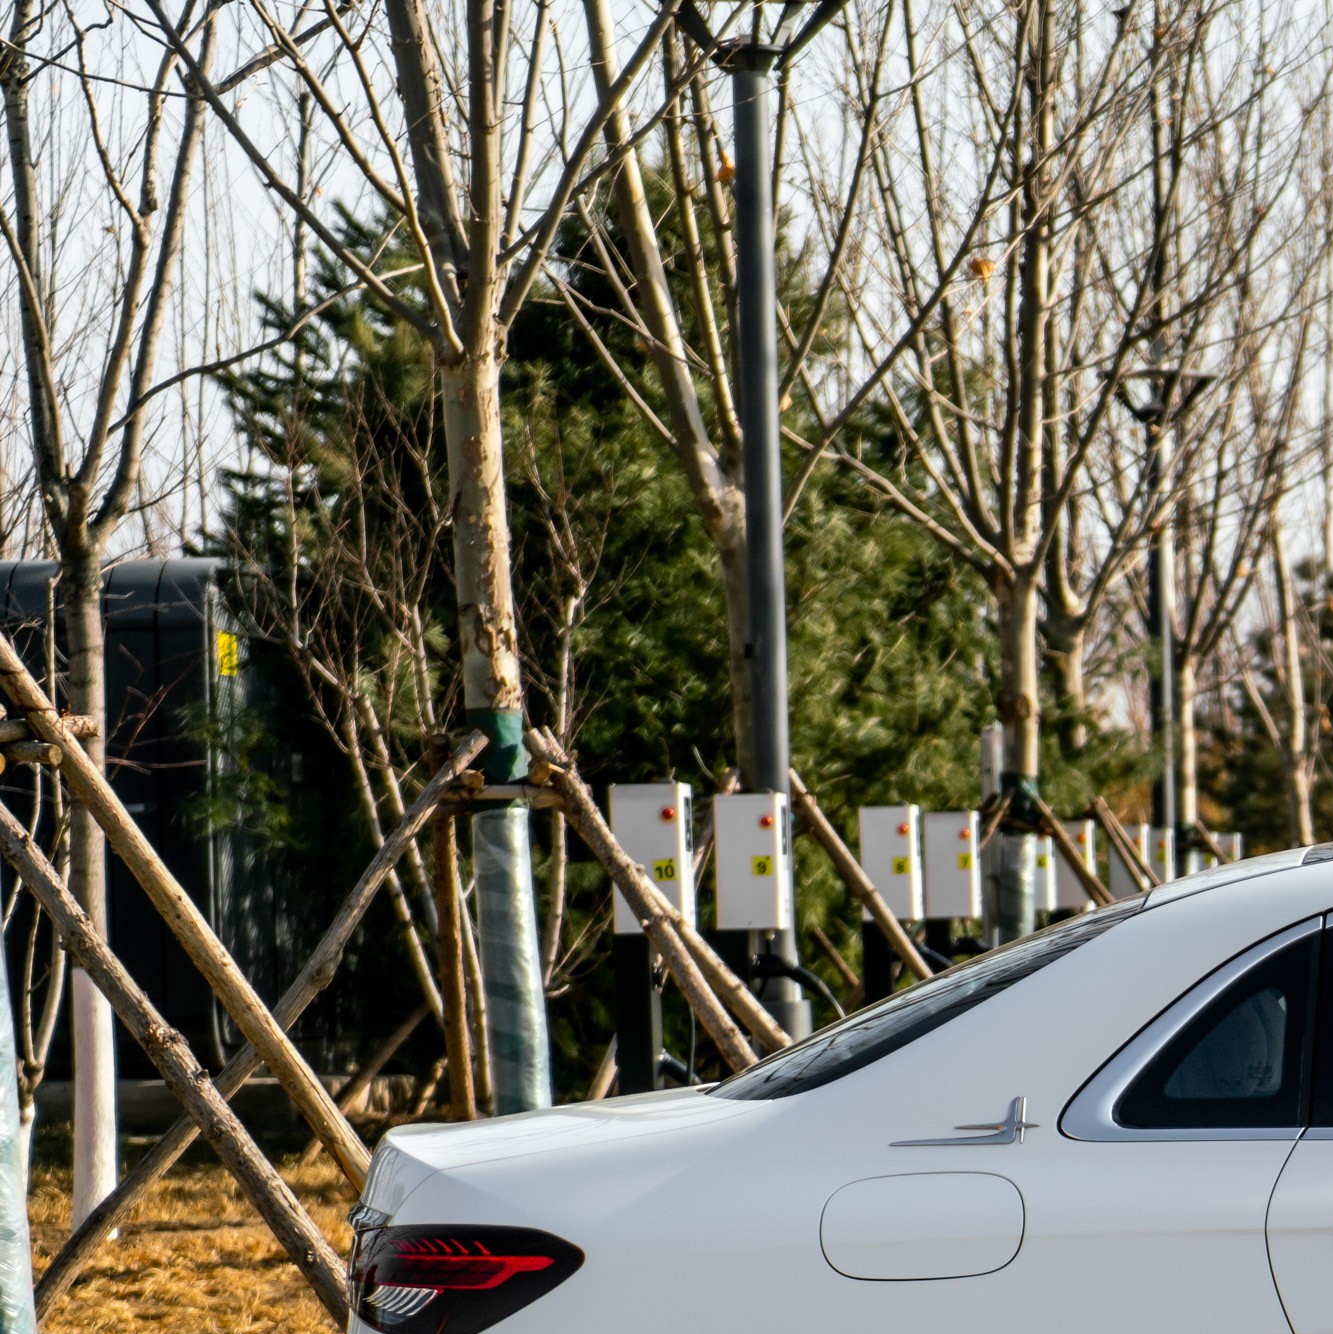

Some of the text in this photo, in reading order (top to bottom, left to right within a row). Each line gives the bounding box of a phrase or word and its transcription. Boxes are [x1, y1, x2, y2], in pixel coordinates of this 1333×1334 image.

[655, 864, 675, 879] 10
[757, 861, 768, 875] 9
[896, 861, 906, 873] 8
